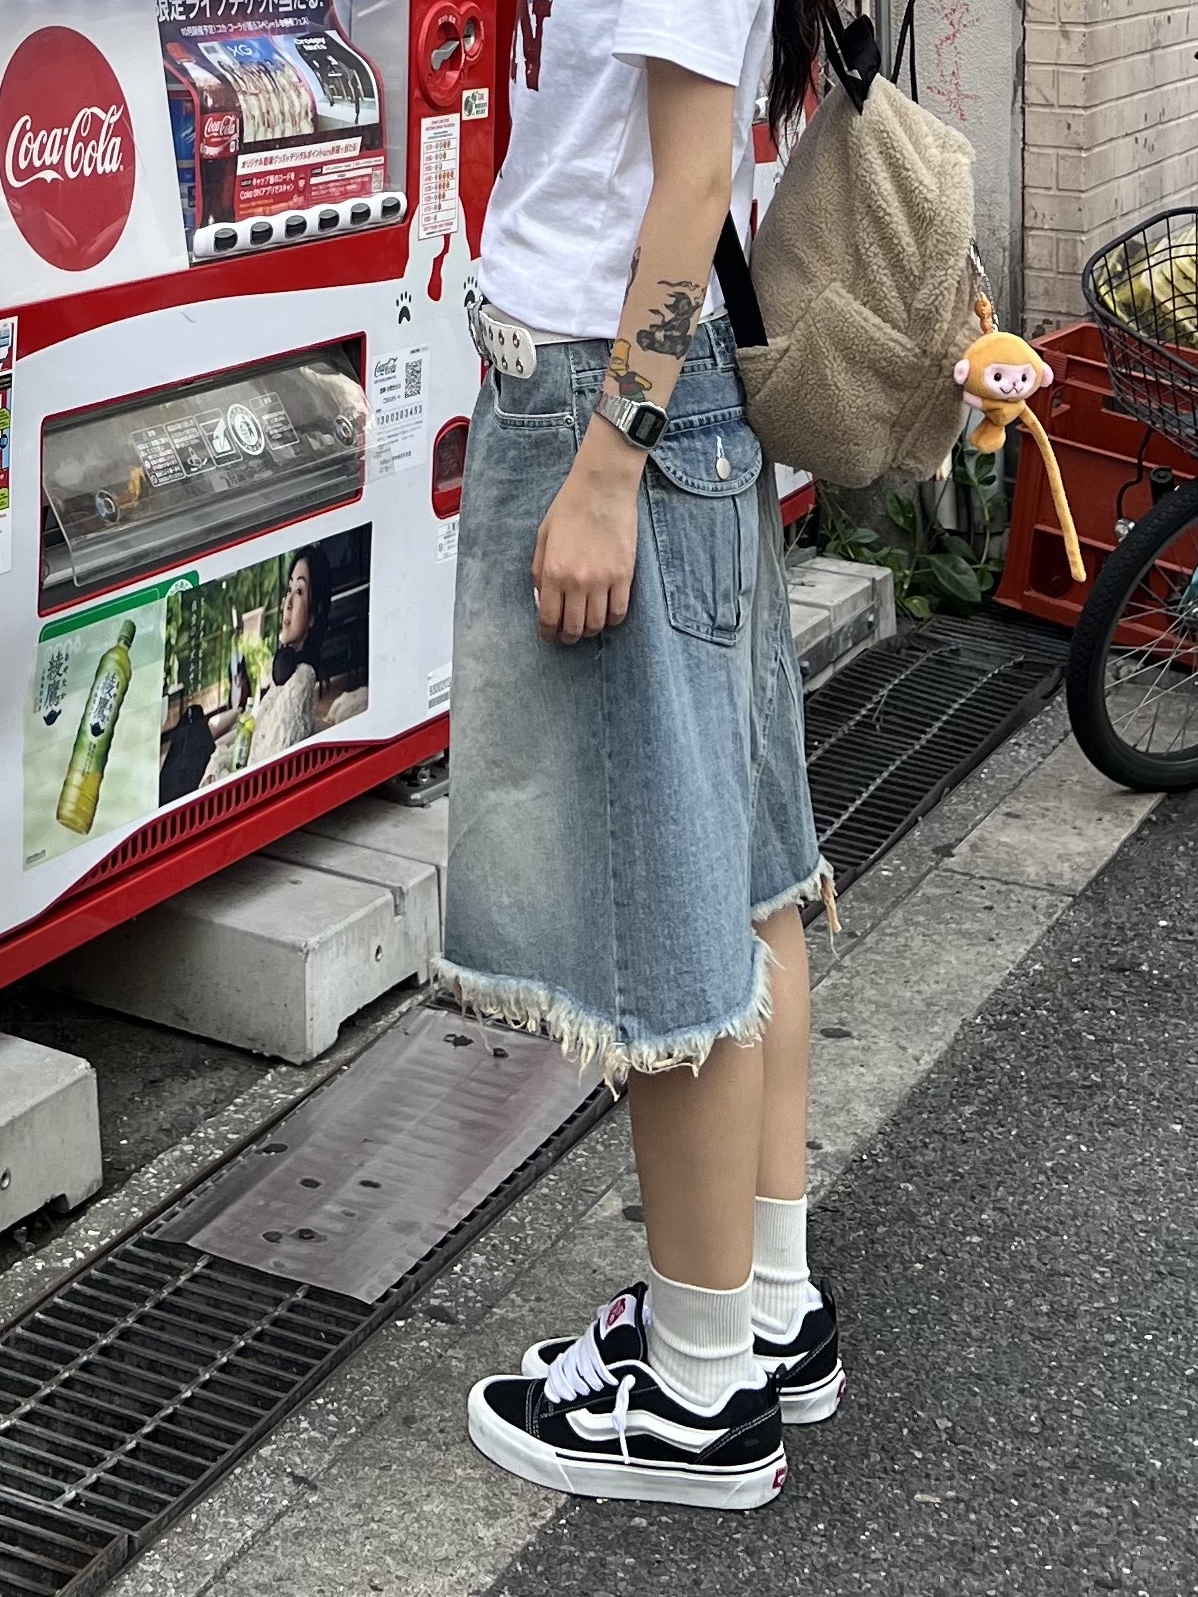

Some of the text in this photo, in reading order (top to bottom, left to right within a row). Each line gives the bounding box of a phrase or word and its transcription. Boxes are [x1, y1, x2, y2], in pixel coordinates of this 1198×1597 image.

[227, 44, 252, 57] XG
[204, 115, 237, 139] Coca-Cola
[5, 103, 124, 188] Coca-Cola
